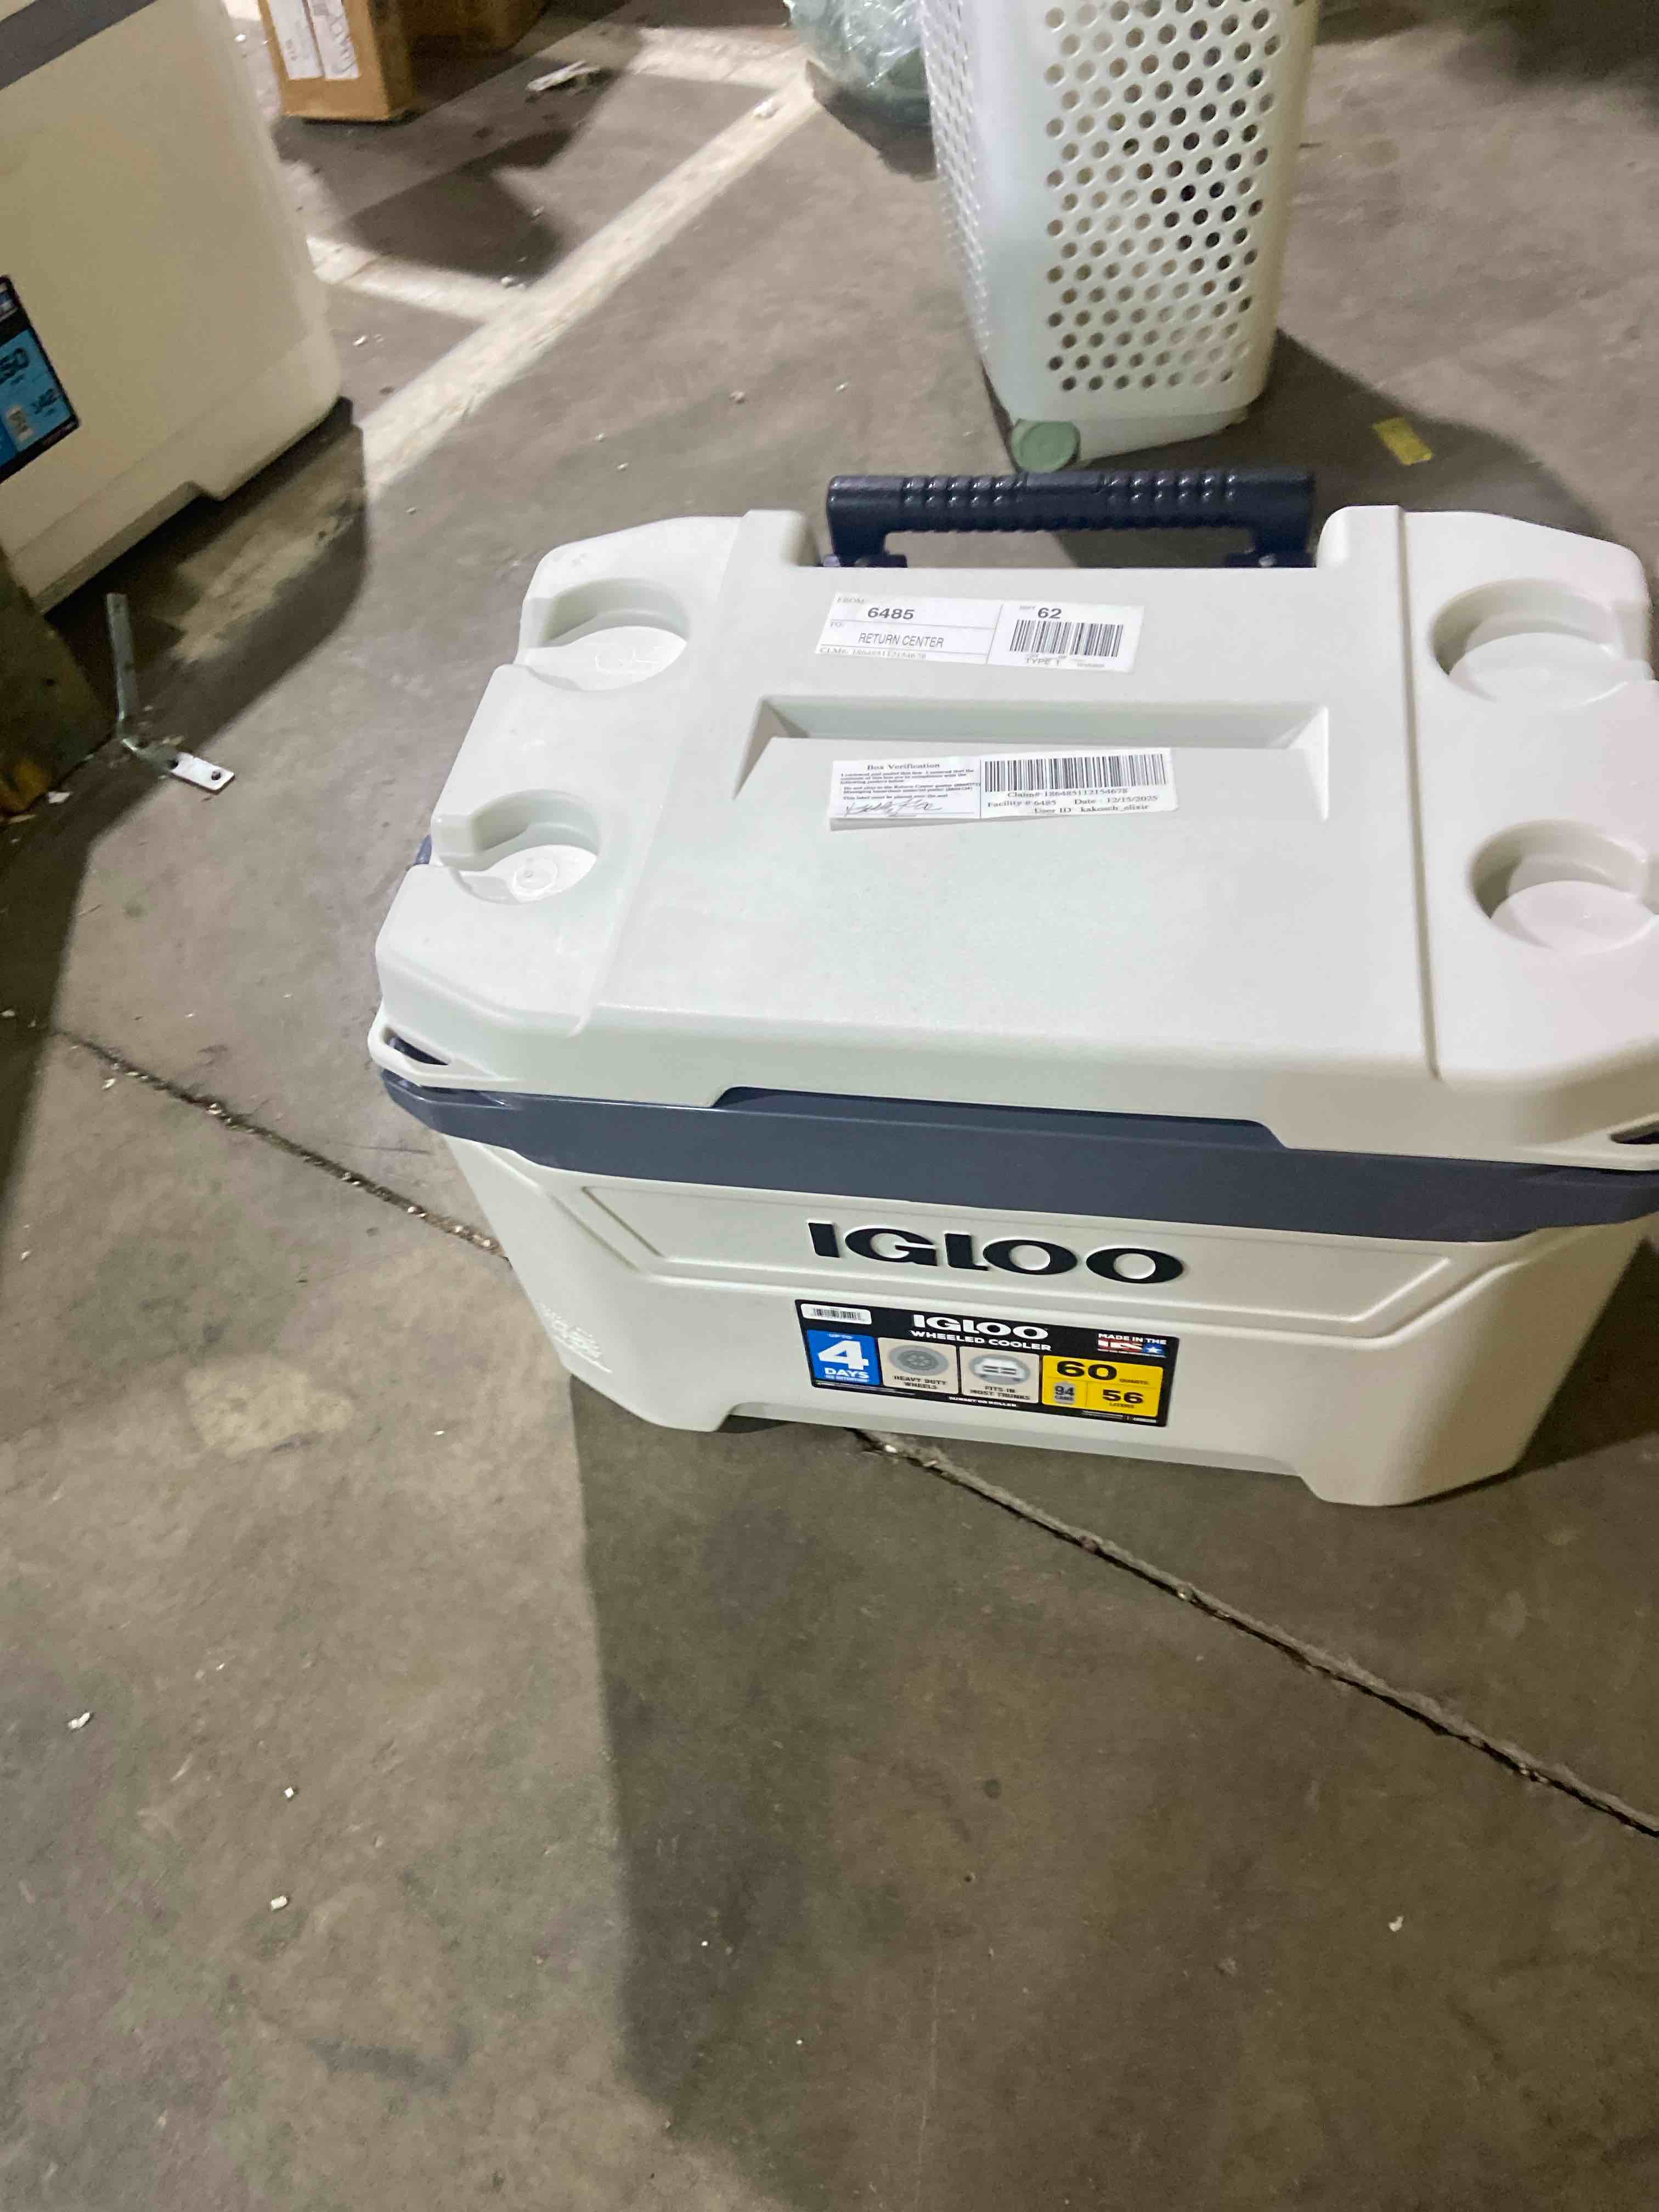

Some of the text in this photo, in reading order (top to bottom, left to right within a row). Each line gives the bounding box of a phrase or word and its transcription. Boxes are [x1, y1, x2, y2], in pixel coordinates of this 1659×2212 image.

[867, 607, 915, 619] 6485
[1038, 607, 1062, 619] 62
[858, 632, 944, 648] RETURN CENTER
[808, 1222, 1184, 1284] IGLOO
[912, 1314, 1048, 1340] IGLOO
[910, 1330, 1052, 1351] WHEELED COOLER
[1098, 1333, 1129, 1341] MADE
[817, 1340, 869, 1370] 4
[824, 1367, 869, 1379] DAYS
[1057, 1361, 1117, 1380] 60
[1054, 1386, 1074, 1396] 94
[1103, 1389, 1143, 1404] 56
